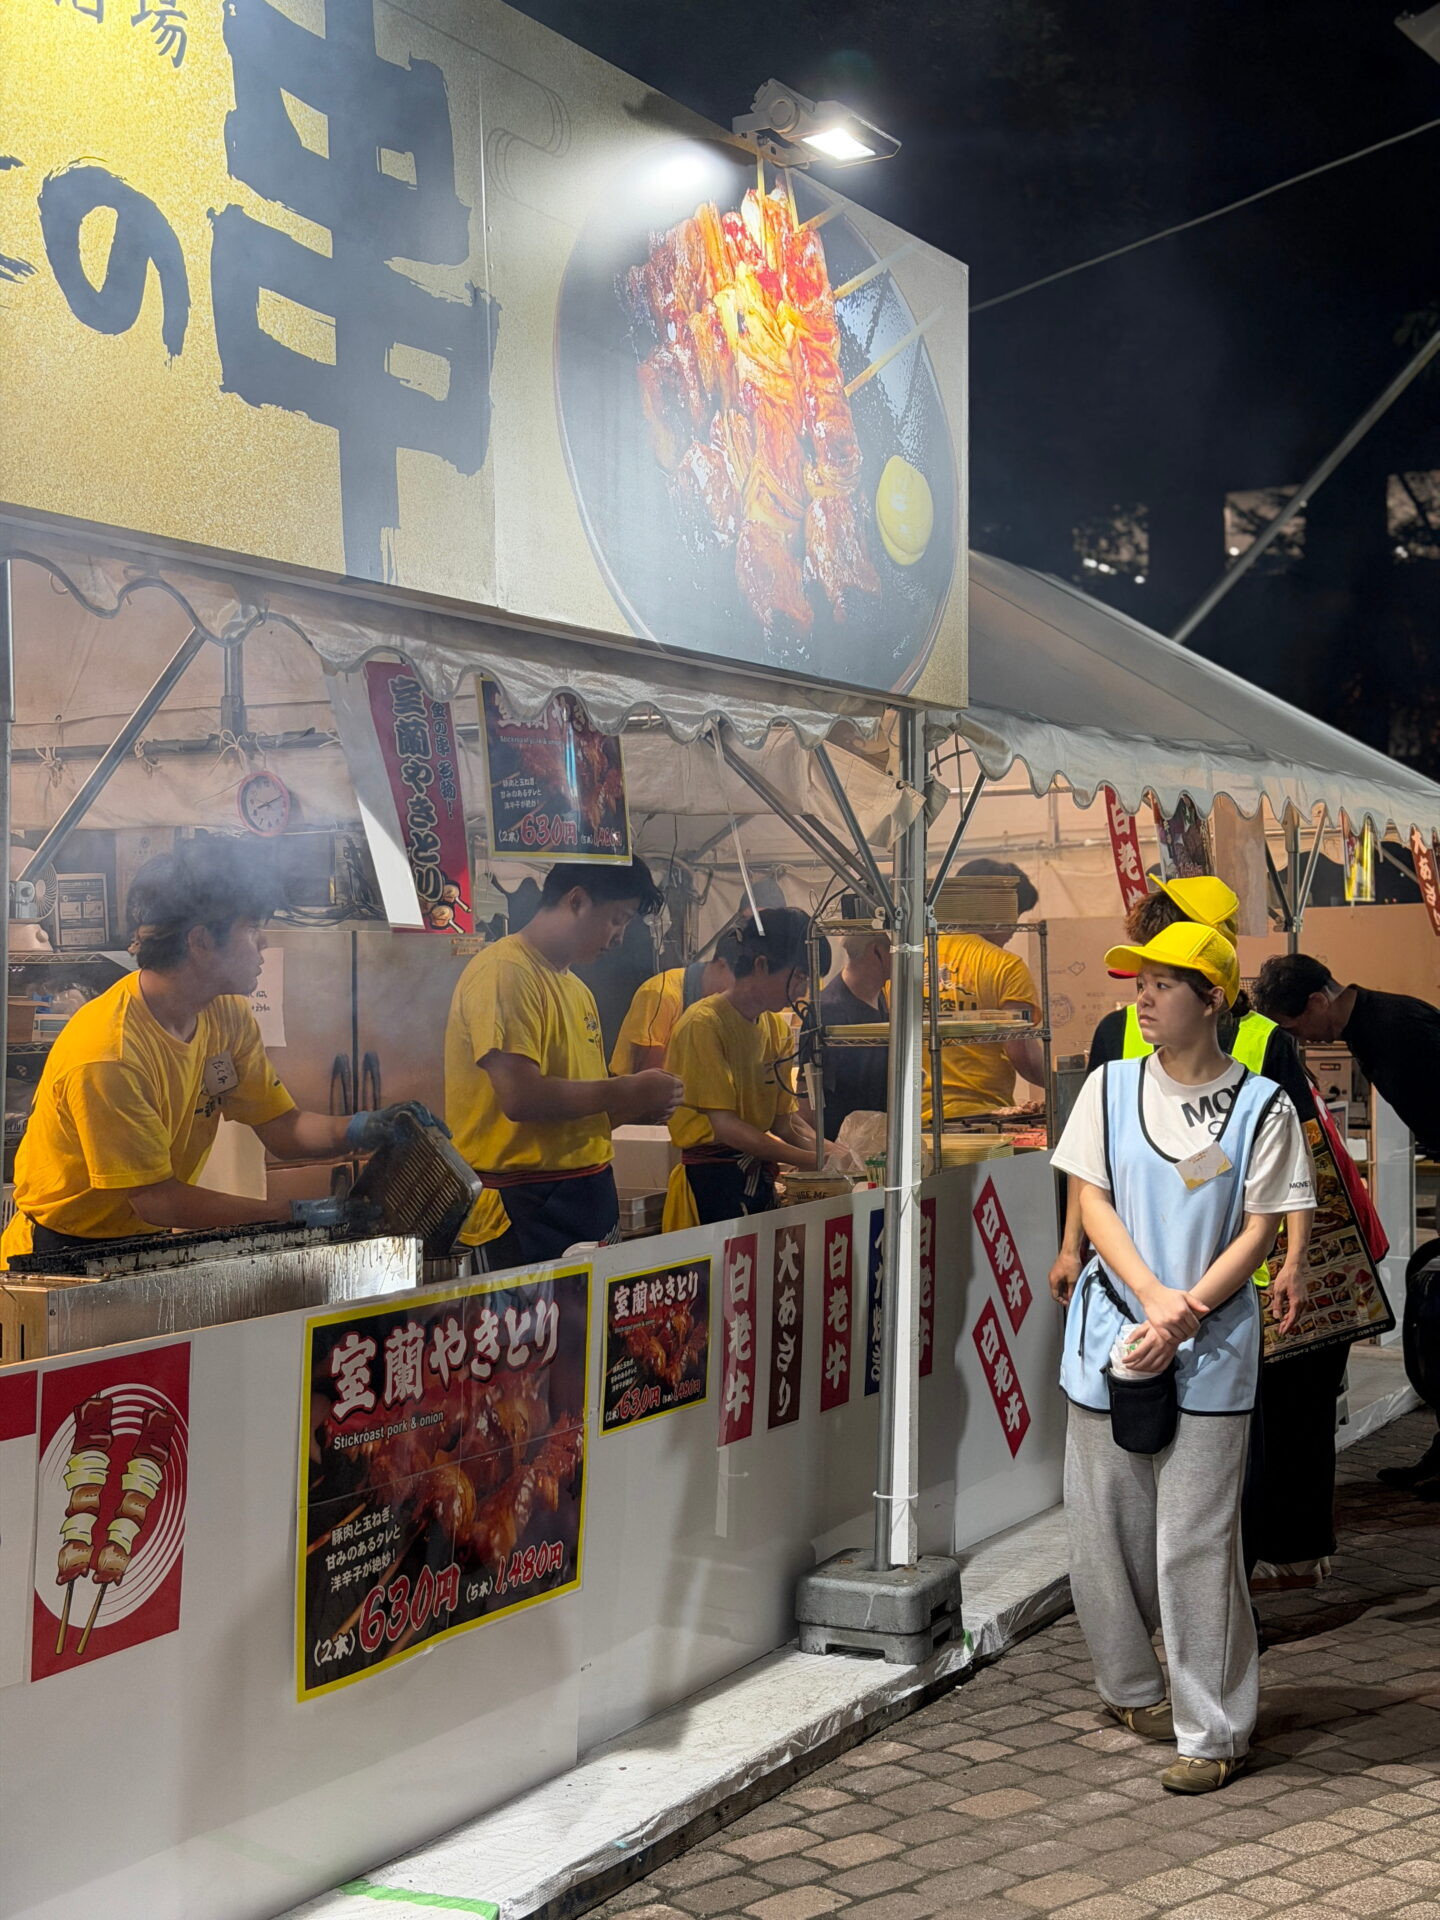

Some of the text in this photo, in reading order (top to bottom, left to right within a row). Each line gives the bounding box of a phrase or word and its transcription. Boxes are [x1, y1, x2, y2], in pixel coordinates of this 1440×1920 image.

[520, 813, 578, 847] 630円
[614, 1271, 698, 1321] 室蘭やきとり
[980, 1196, 1024, 1309] 白老牛
[332, 1299, 560, 1418] 室蘭やきとり
[725, 1252, 752, 1421] 白老牛
[777, 1232, 800, 1417] 大あさり
[826, 1231, 849, 1389] 白老牛
[333, 1411, 444, 1450] Stickroast pork & onion
[620, 1383, 661, 1419] 630円
[980, 1317, 1023, 1433] 白老牛
[313, 1540, 565, 1667] (2本) 630円 (5本) 1,480円
[325, 1524, 401, 1572] 甘みのあるタレと
[330, 1548, 396, 1593] 洋辛子が絶妙!
